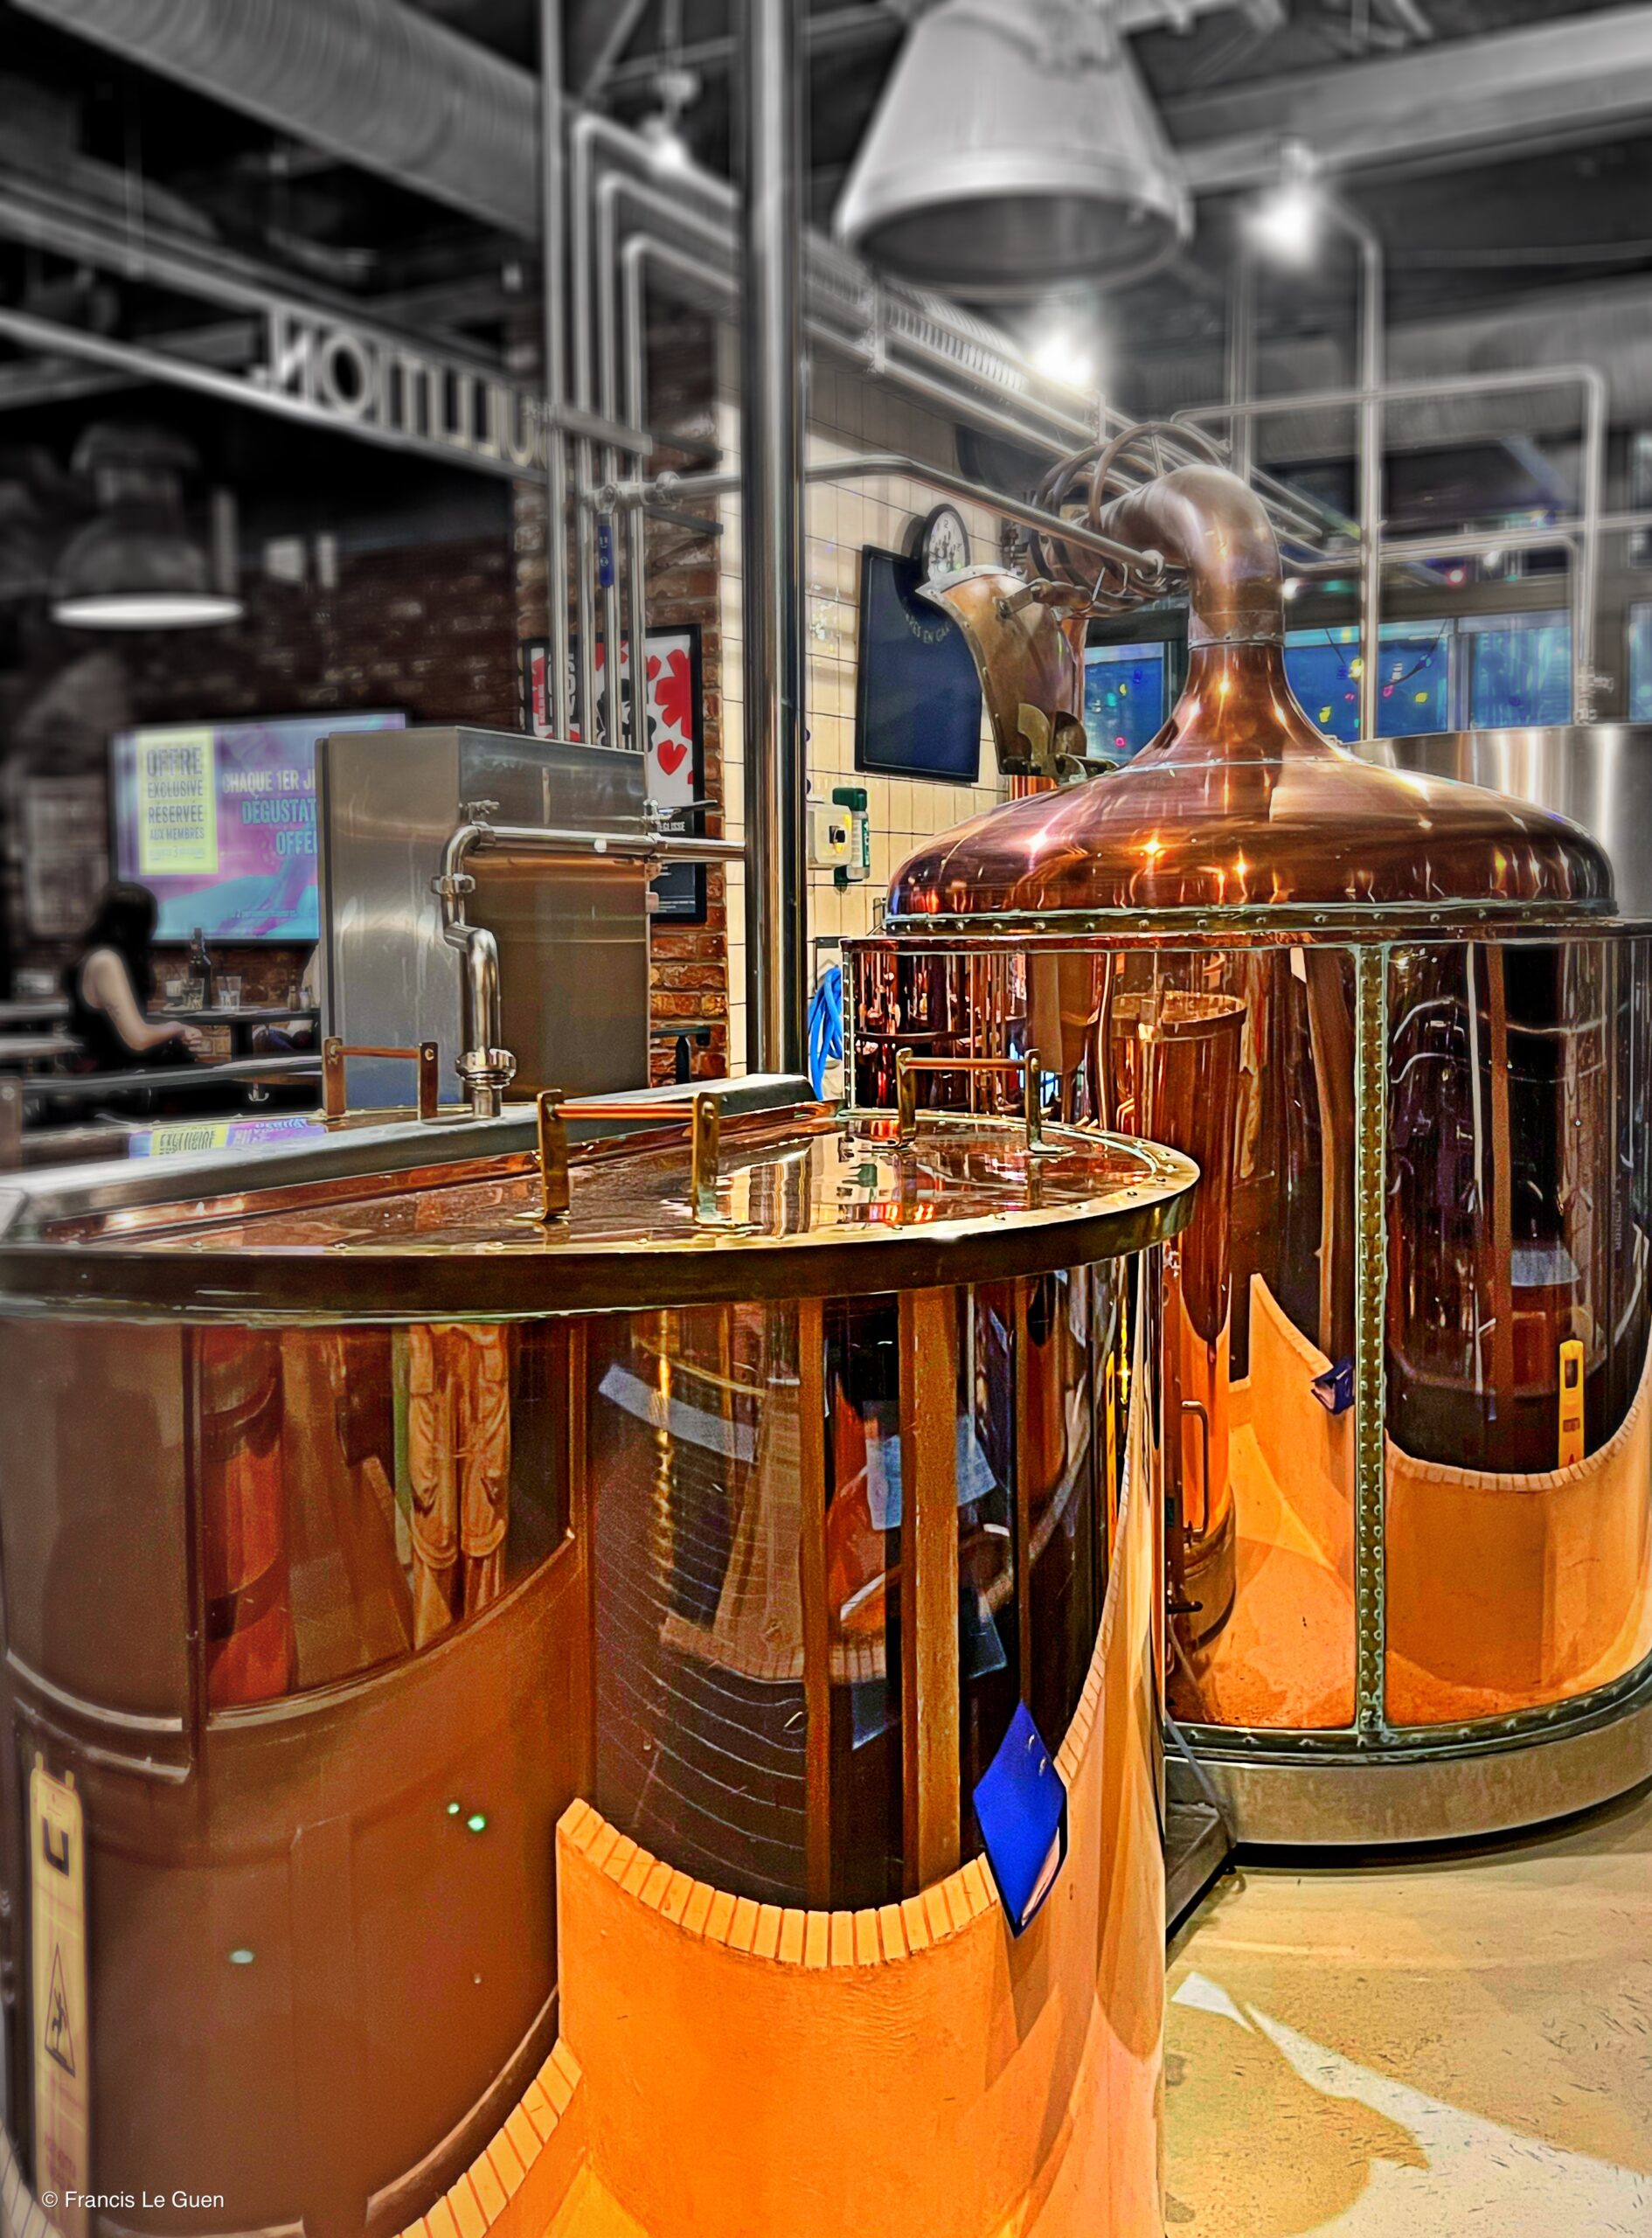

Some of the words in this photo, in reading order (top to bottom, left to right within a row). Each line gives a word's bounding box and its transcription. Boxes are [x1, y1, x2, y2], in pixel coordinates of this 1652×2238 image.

[147, 747, 202, 776] OFFRE
[148, 780, 204, 799] EXCLUSIVE
[222, 770, 274, 796] CHAQUE
[276, 769, 300, 791] 1ER
[149, 828, 164, 841] AUX
[166, 826, 205, 841] MEMBRES
